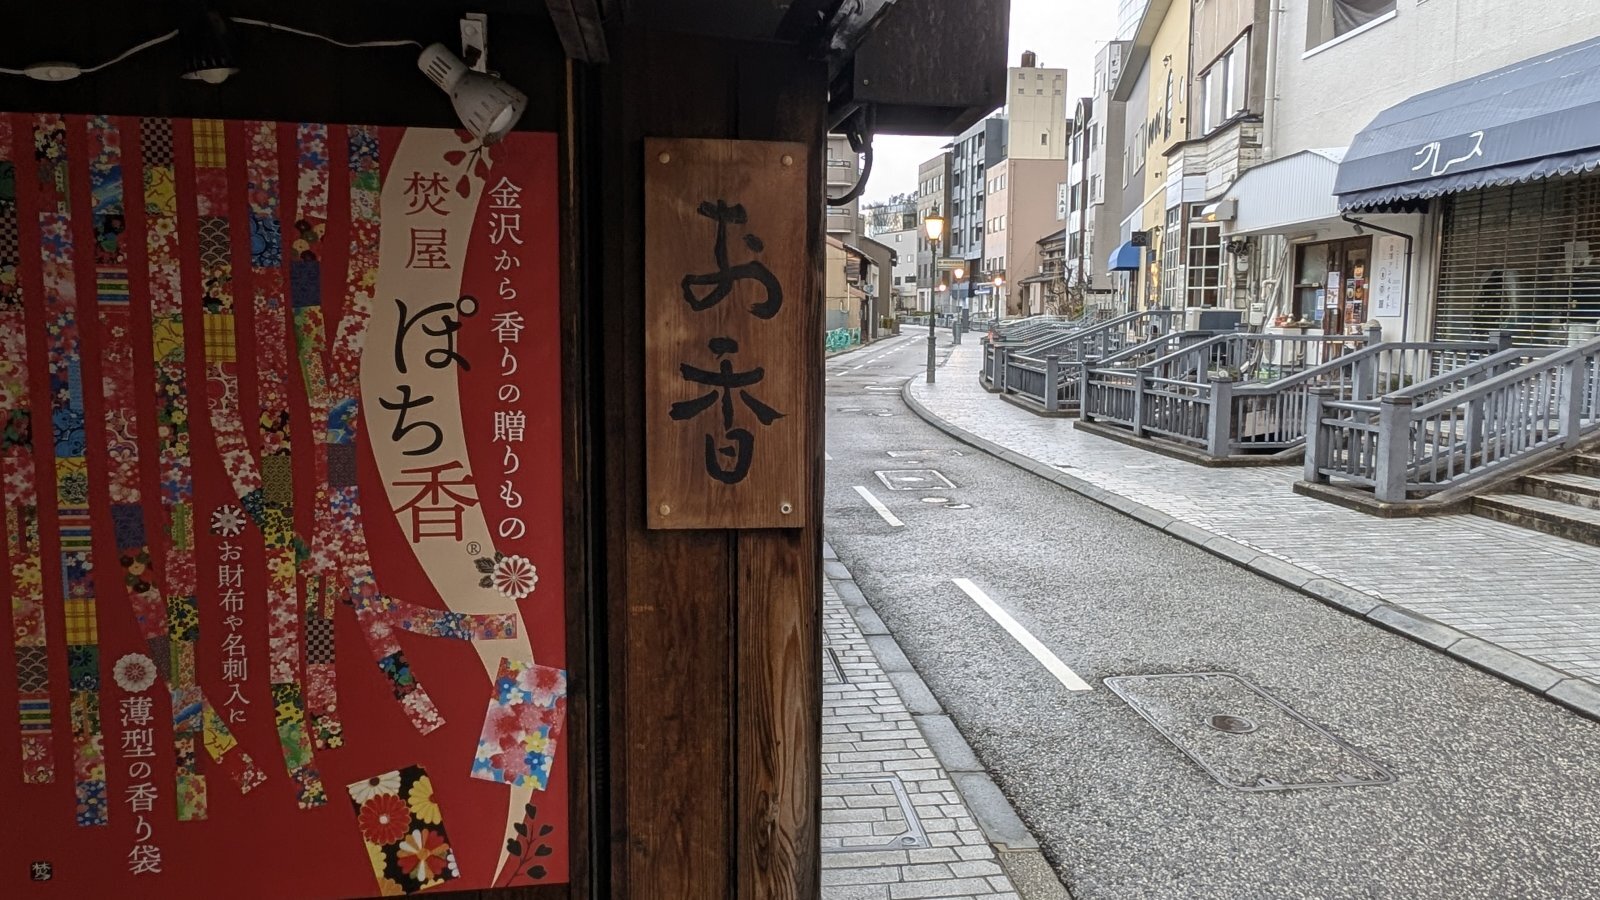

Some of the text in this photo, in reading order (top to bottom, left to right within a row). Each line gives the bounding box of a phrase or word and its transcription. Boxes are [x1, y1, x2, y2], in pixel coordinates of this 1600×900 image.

[379, 171, 480, 544] 焚屋 ぽち香
[488, 176, 526, 540] 金沢から香りの贈りもの
[669, 199, 789, 484] お香
[218, 541, 250, 724] お財布や名刺入に
[119, 696, 163, 875] 薄型の香り袋
